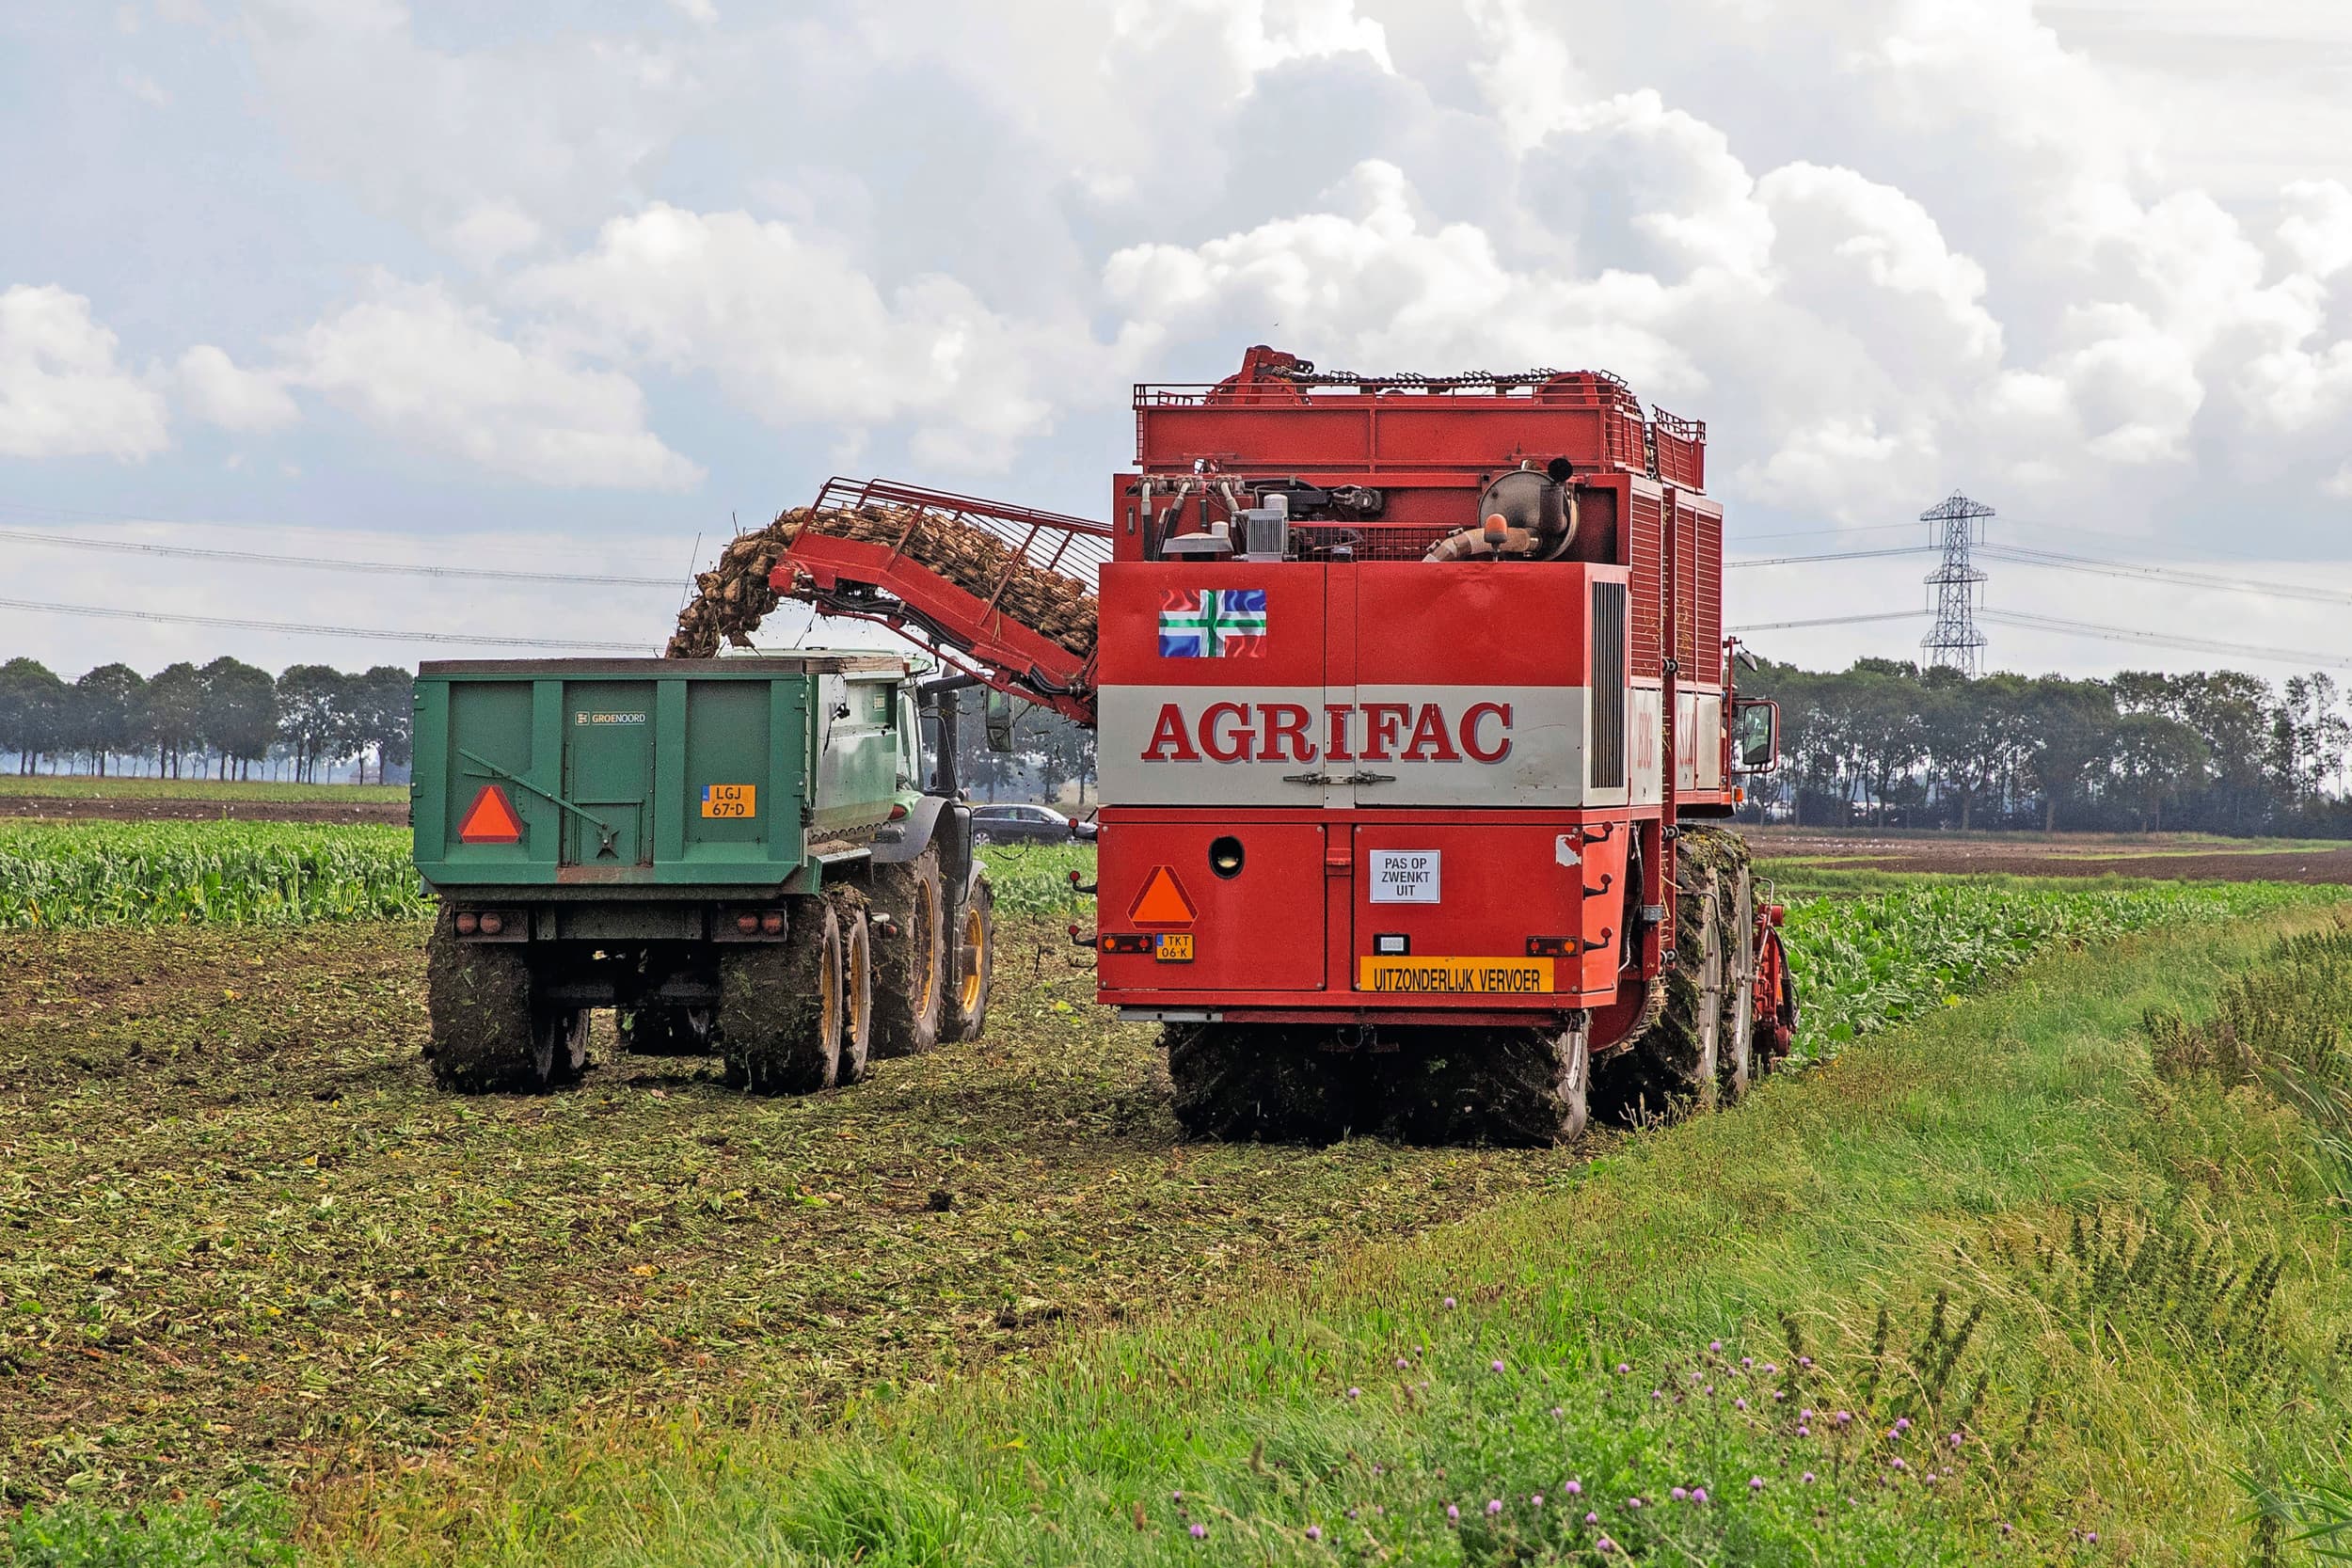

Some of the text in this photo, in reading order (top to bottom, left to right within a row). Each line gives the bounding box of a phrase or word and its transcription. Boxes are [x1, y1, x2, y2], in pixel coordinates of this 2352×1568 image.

[592, 714, 646, 723] GROENOORD
[1140, 702, 1511, 763] AGRIFAC
[716, 786, 741, 800] LGJ
[712, 803, 745, 816] 67-D
[1385, 857, 1427, 869] PAS OP
[1381, 871, 1430, 883] ZWENKT
[1396, 884, 1415, 895] UIT
[1168, 936, 1189, 946] TKT
[1162, 947, 1187, 958] 06-K
[1374, 968, 1540, 992] UITZONDERLIJK VERVOER
